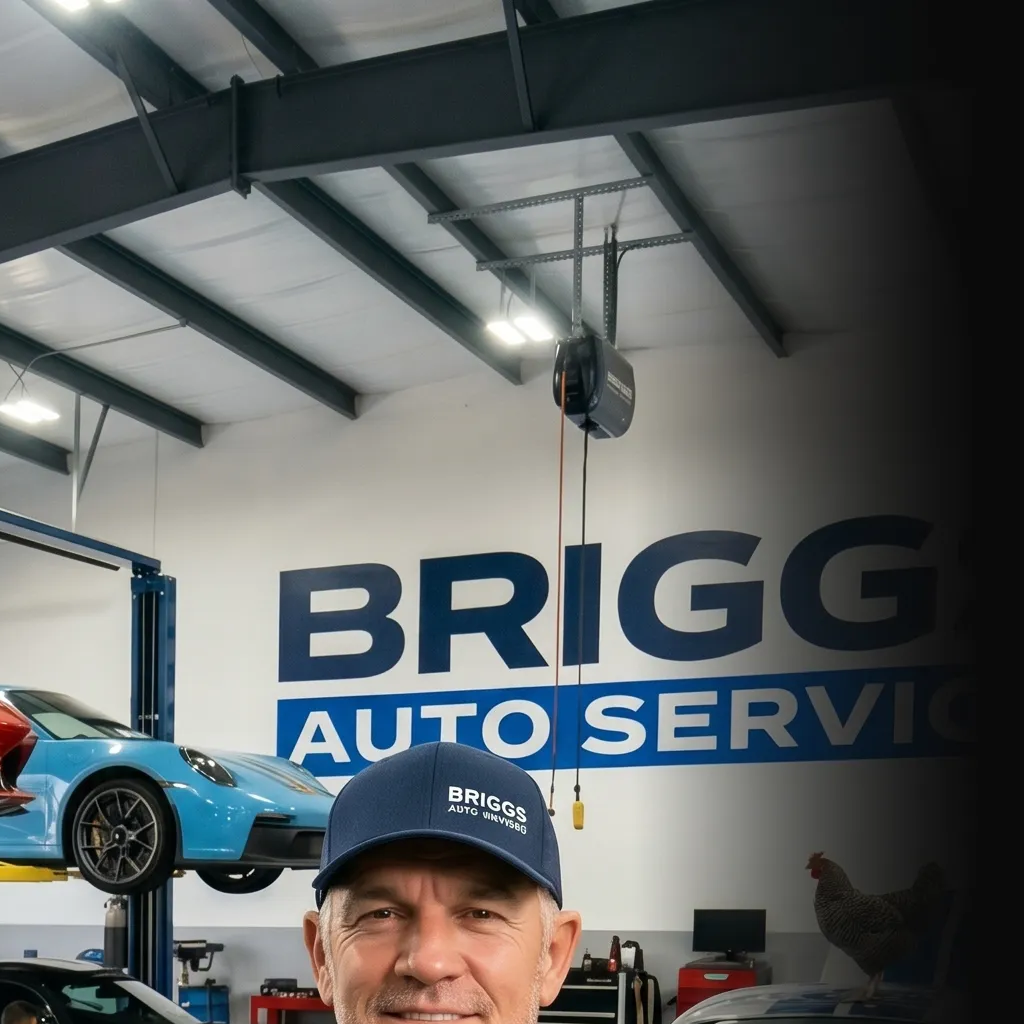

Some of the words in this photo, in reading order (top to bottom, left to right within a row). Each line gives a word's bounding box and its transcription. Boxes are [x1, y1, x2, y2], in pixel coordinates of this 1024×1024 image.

[278, 514, 974, 682] BRIGG
[288, 699, 551, 765] AUTO
[448, 786, 527, 823] BRIGGS
